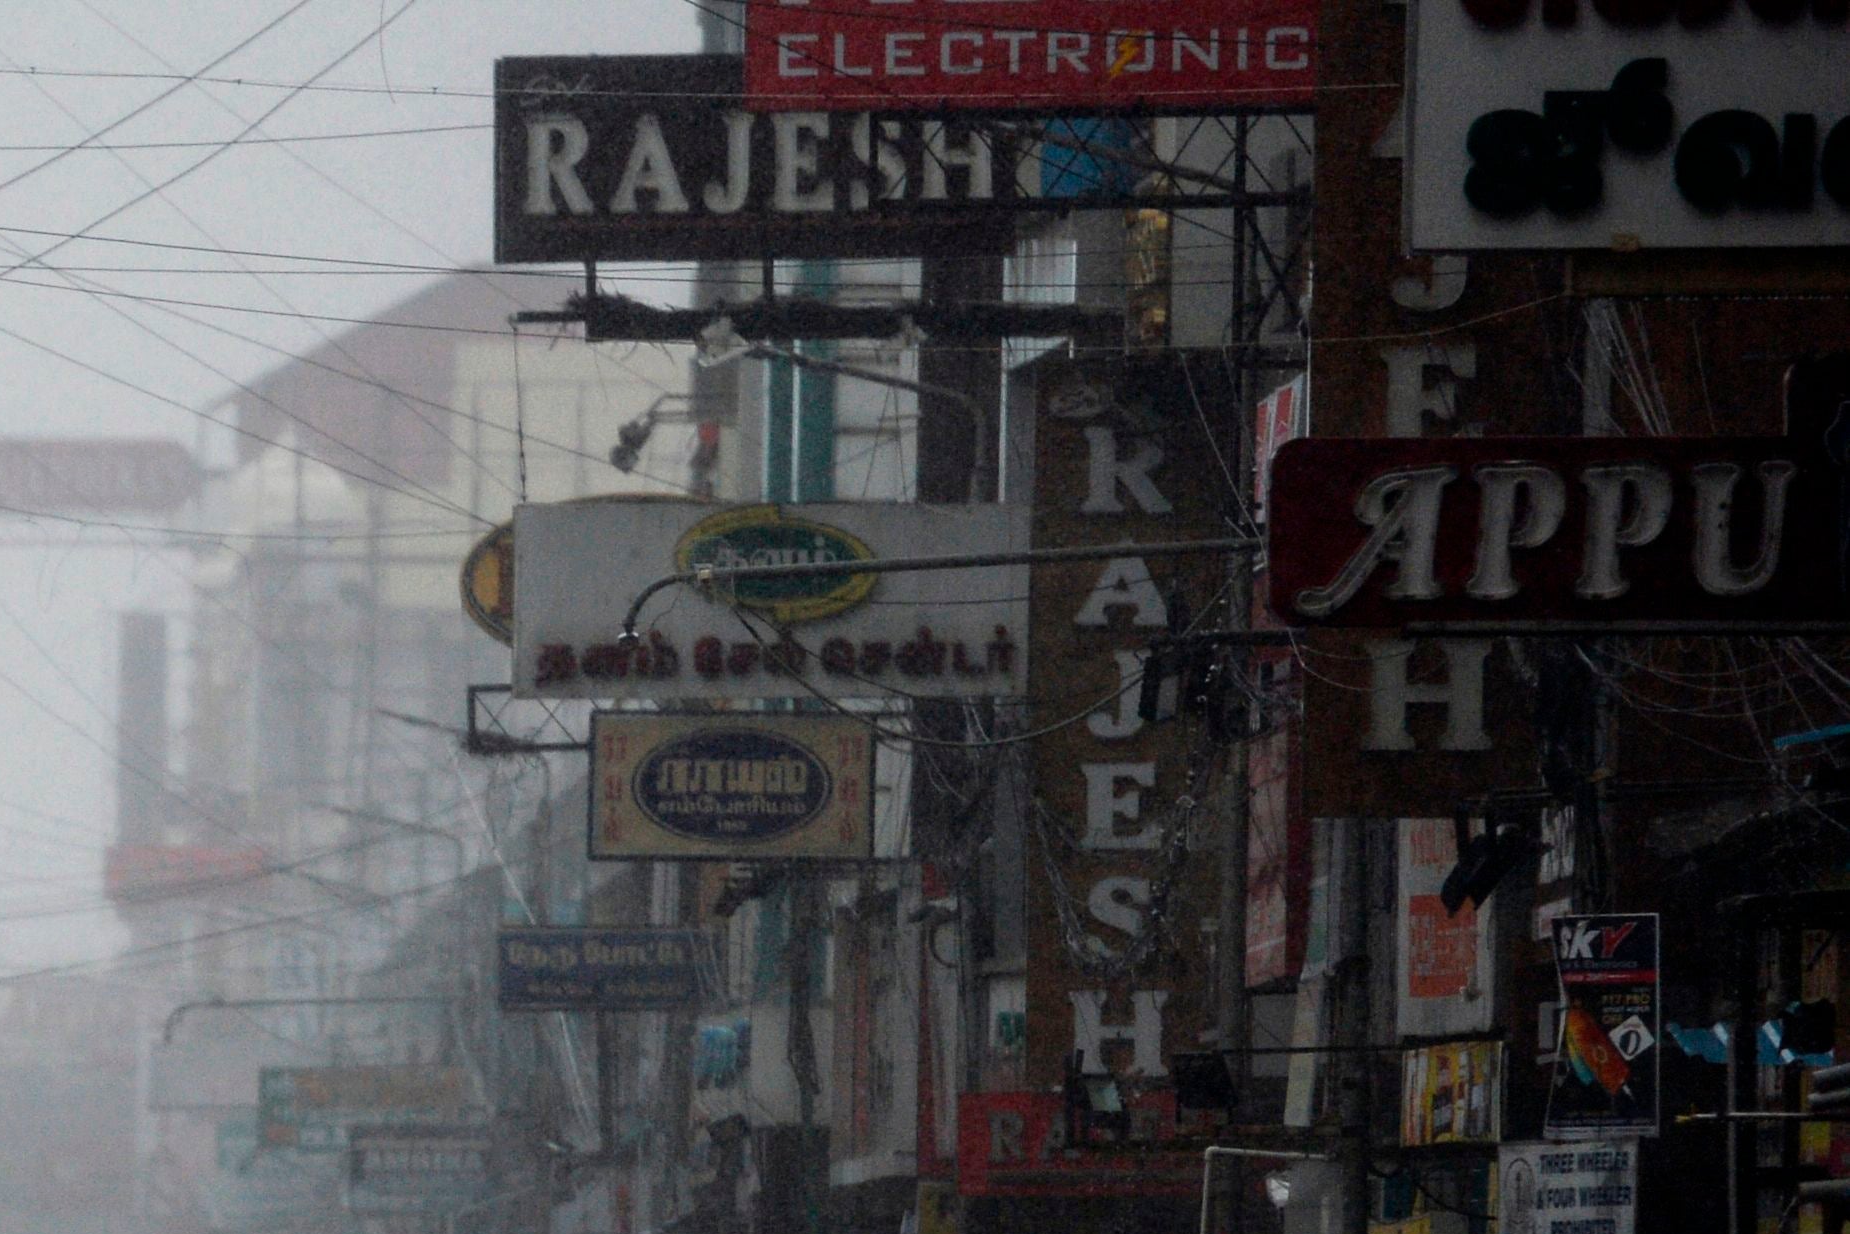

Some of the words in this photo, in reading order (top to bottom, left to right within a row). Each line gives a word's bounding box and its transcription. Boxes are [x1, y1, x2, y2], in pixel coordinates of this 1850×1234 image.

[525, 111, 994, 214] RAJESH
[1295, 461, 1797, 618] APPU
[1540, 1153, 1574, 1174] THREE
[1578, 1152, 1629, 1173] WHEELER
[1546, 1189, 1576, 1209] FOUR
[1580, 1186, 1631, 1207] WHEELER
